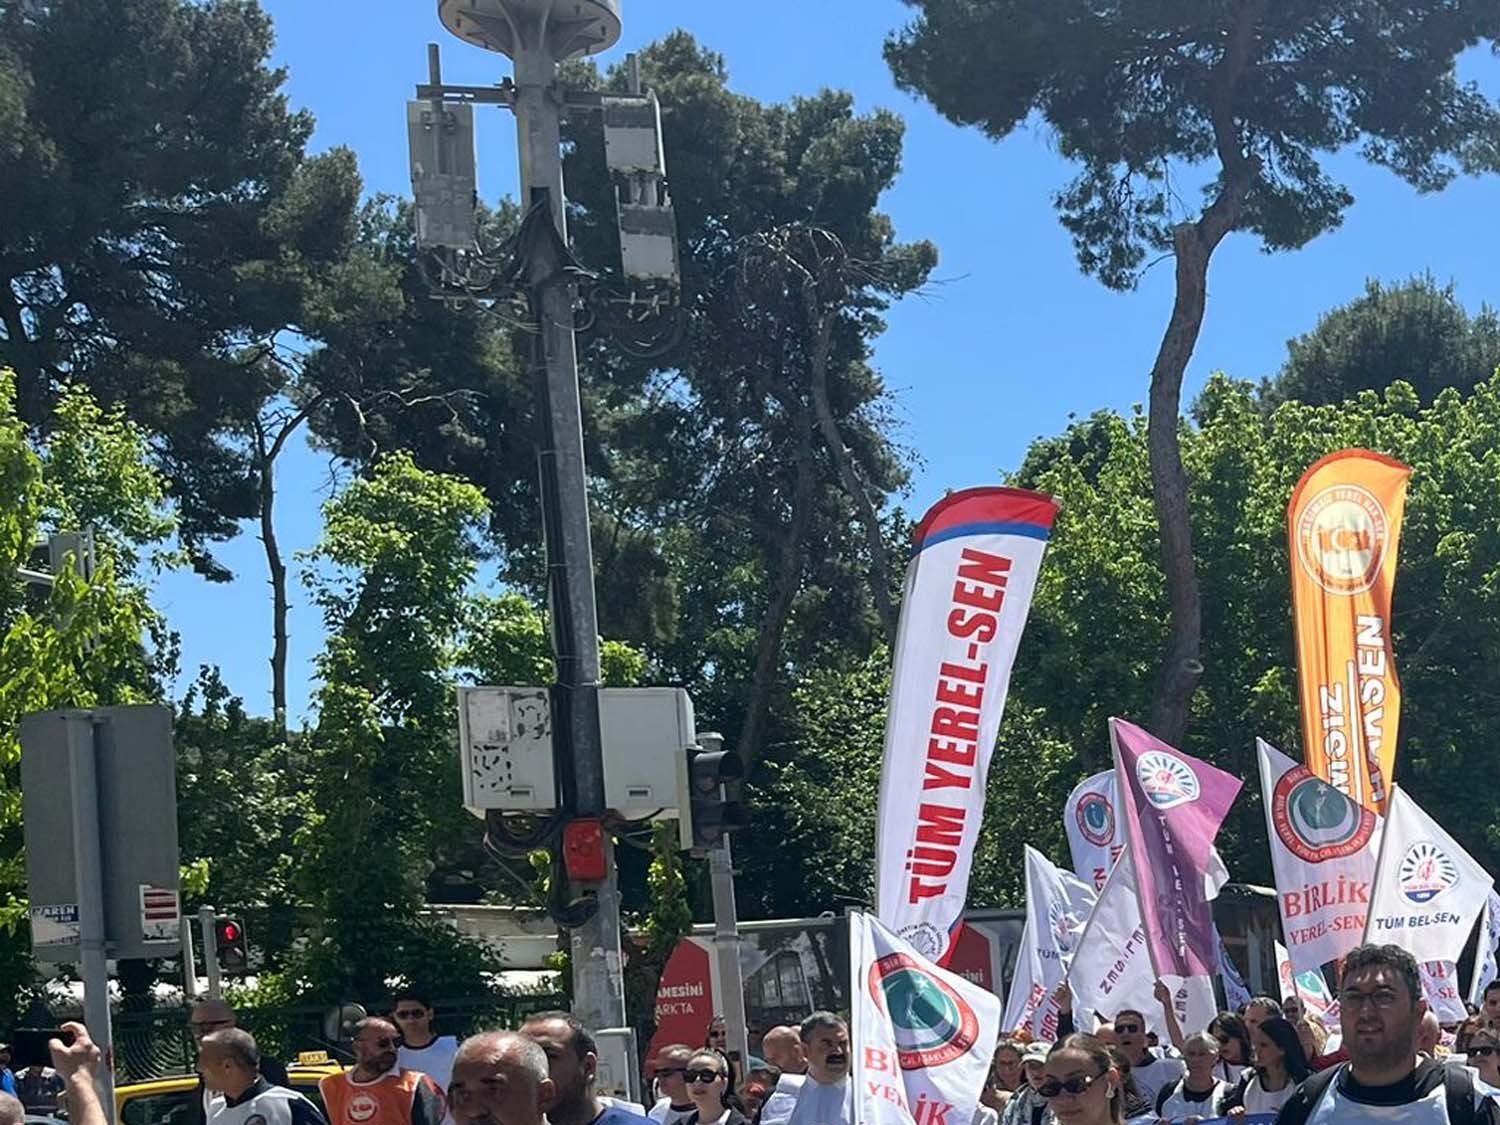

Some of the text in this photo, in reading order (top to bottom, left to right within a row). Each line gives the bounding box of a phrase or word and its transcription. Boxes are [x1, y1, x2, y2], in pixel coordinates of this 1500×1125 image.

[922, 547, 1013, 791] YEREL-SEN
[905, 802, 967, 904] TÜM
[1283, 874, 1370, 919] BİRLİK
[1376, 911, 1460, 930] TÜM BEL-SEN
[1289, 914, 1365, 946] YEREL-SEN
[1099, 924, 1145, 996] EL-SEN
